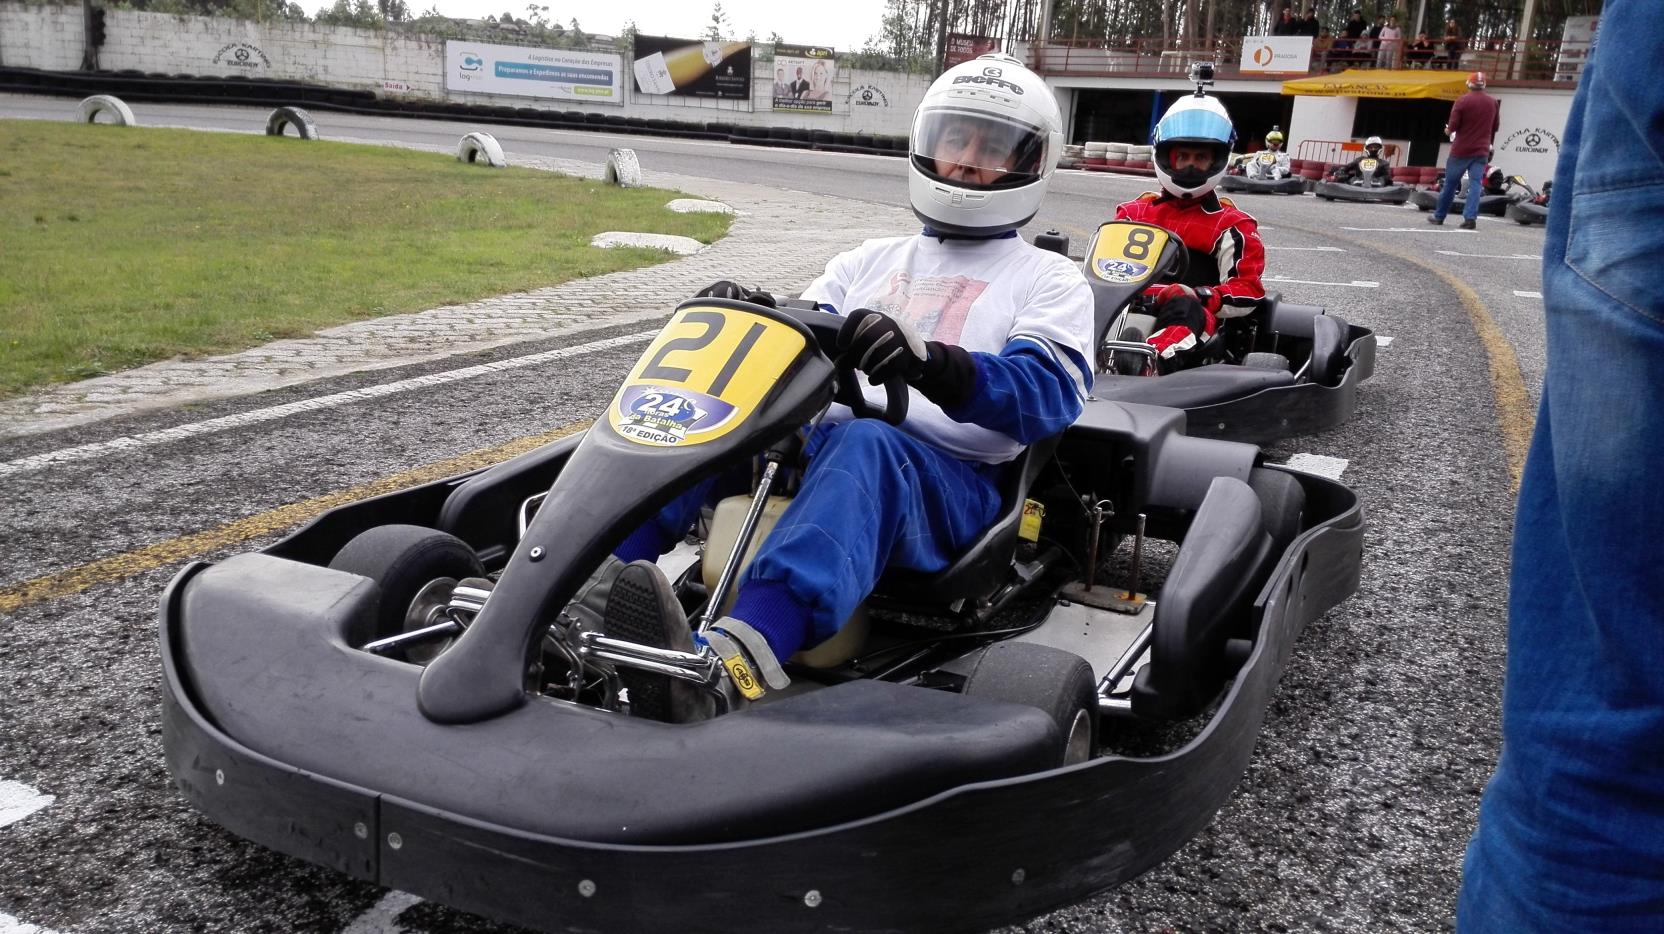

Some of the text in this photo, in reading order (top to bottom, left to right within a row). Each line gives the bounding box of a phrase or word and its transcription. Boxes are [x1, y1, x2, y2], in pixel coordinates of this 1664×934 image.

[1500, 127, 1530, 151] ESCOLA
[1123, 228, 1155, 260] 8
[1108, 261, 1128, 272] 24
[638, 311, 768, 398] 21
[637, 393, 684, 417] 24
[629, 412, 683, 431] da Batalha
[637, 430, 677, 444] EDIÇÃO
